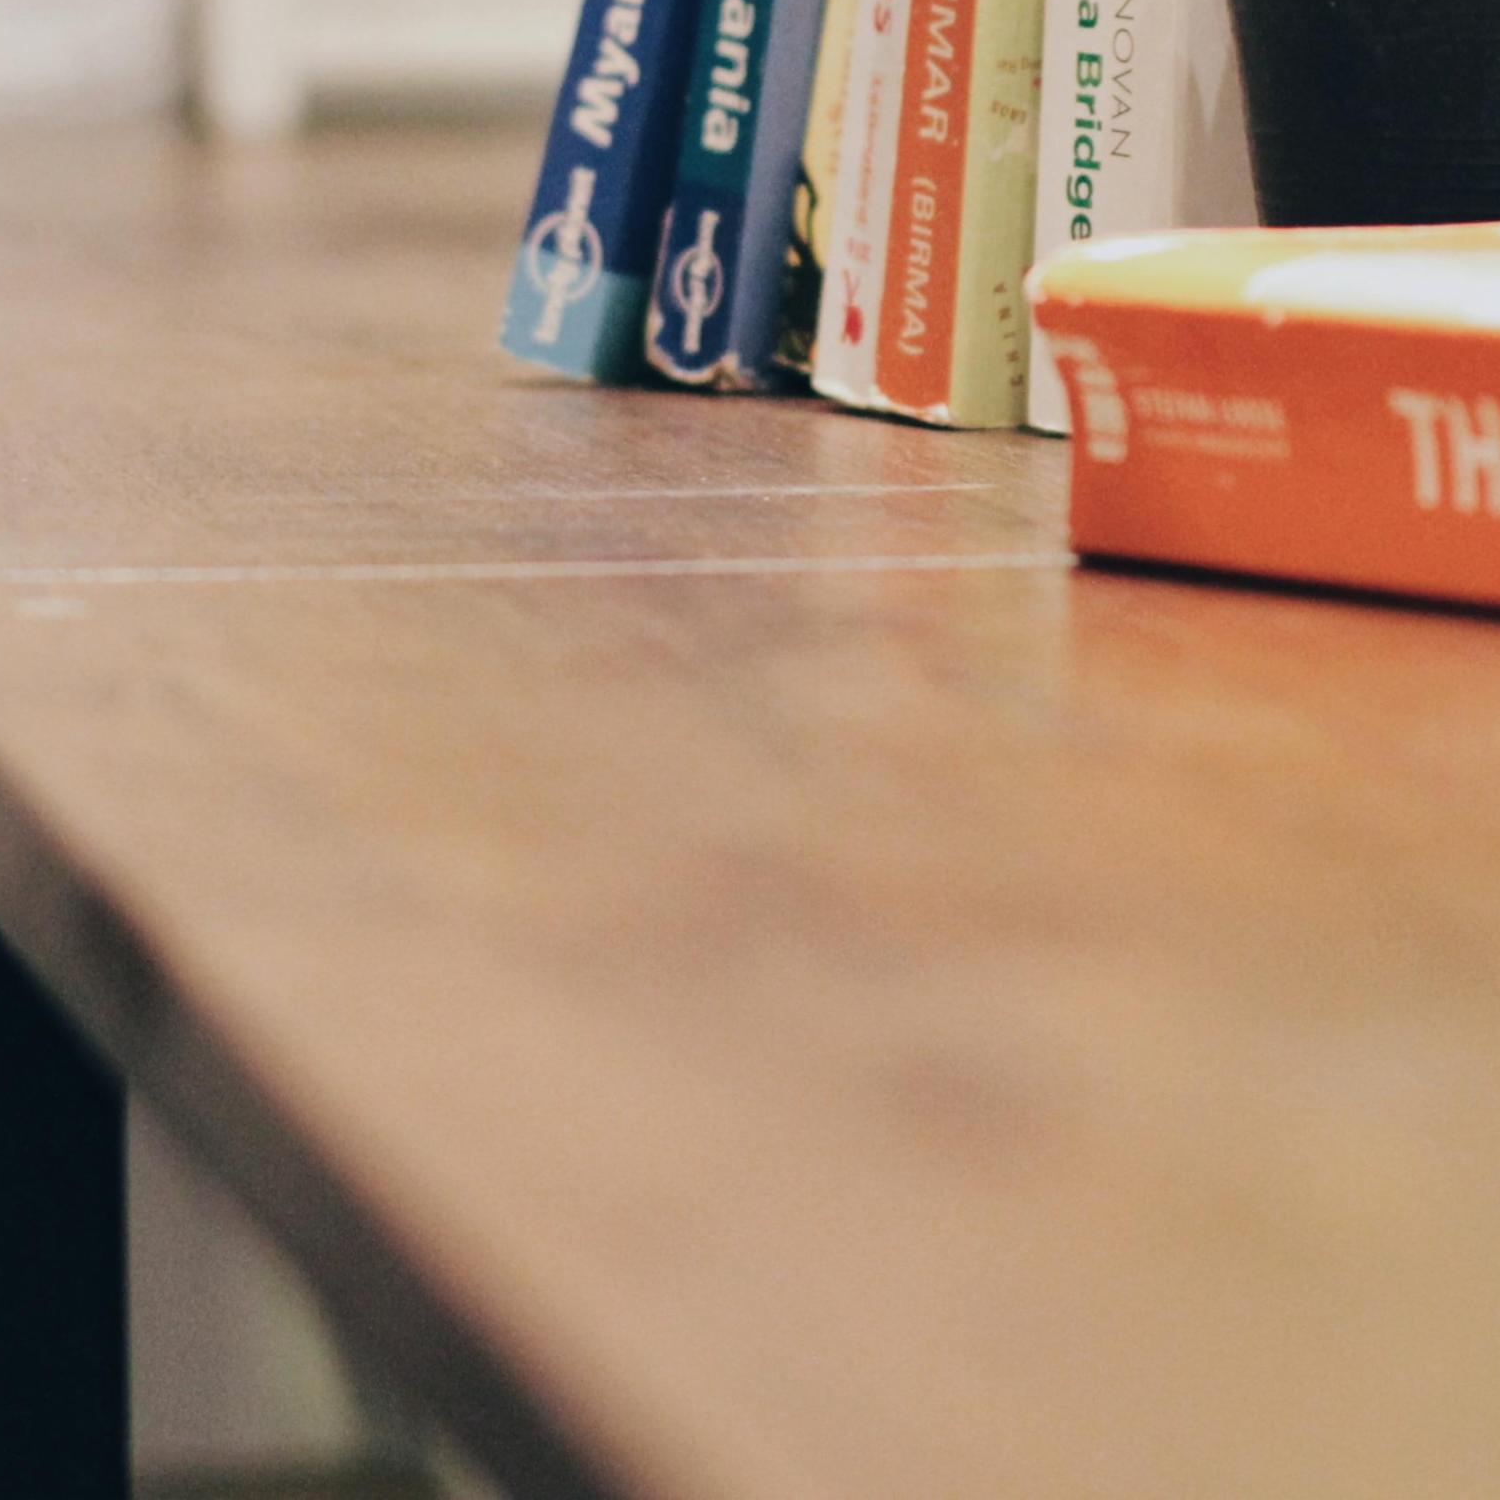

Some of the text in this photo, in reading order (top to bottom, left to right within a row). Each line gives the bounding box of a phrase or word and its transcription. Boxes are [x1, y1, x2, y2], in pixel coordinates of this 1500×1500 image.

[1077, 0, 1101, 30] a
[1065, 52, 1105, 242] Bridge
[899, 176, 937, 356] (BIRMA)
